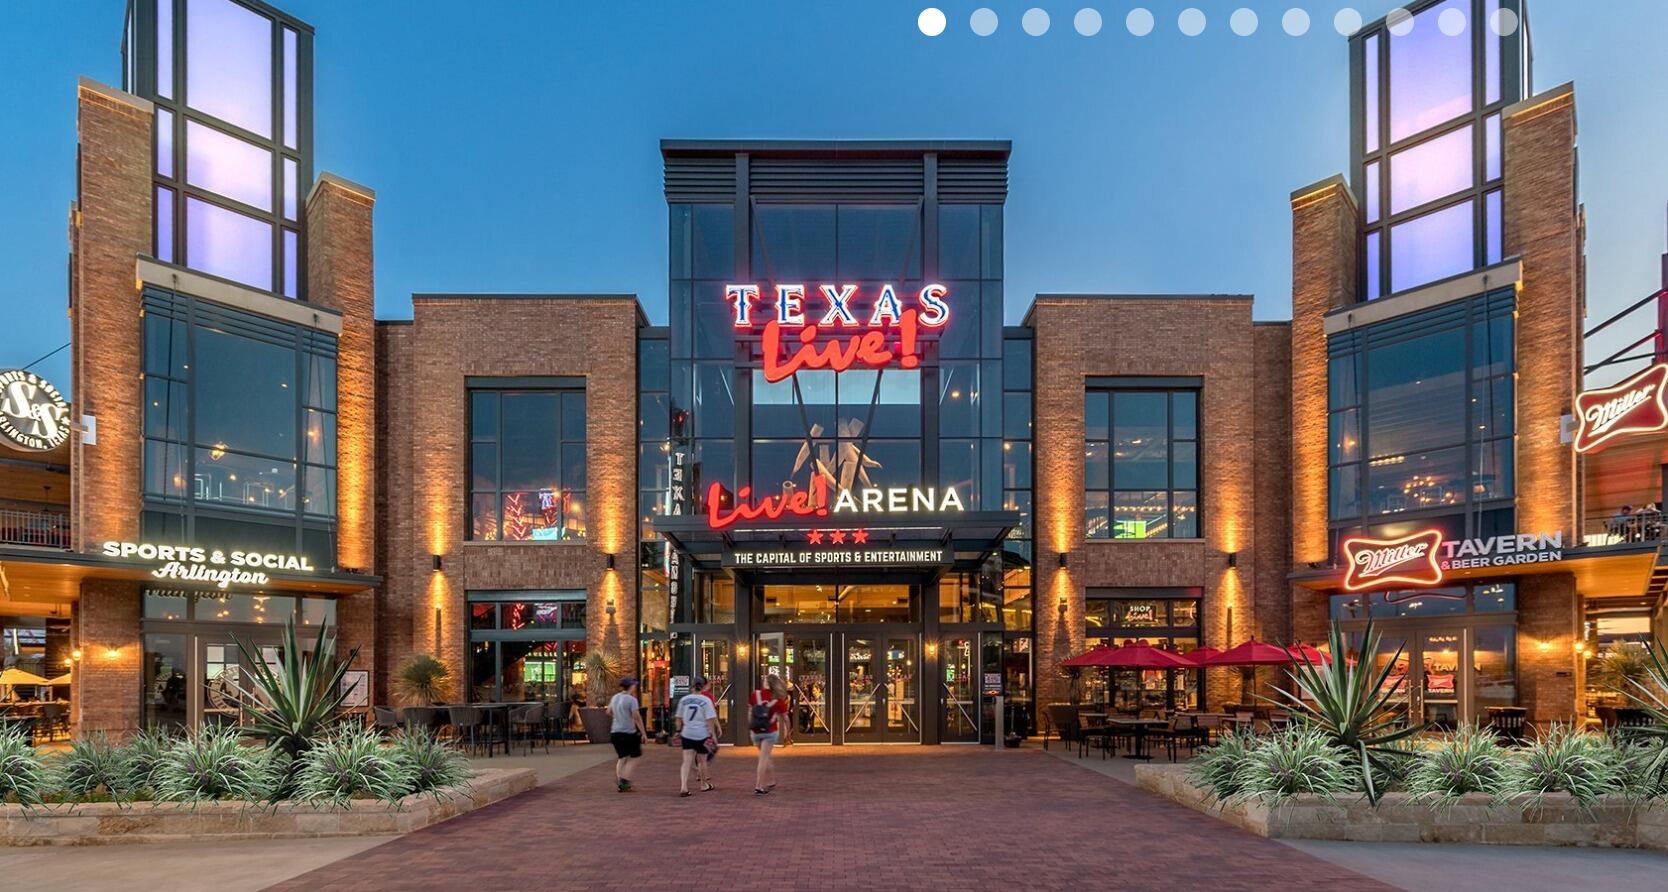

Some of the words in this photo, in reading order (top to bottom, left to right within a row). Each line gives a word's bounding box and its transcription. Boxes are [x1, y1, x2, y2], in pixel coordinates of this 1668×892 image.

[726, 284, 950, 327] TEXAS
[761, 309, 918, 383] Live!
[1585, 384, 1656, 430] Miller
[47, 425, 70, 447] TEXAS
[708, 474, 828, 529] Live!
[834, 487, 965, 512] ARENA
[103, 541, 206, 563] SPORTS
[209, 550, 226, 564] &
[230, 551, 314, 571] SOCIAL
[734, 553, 753, 564] THE
[756, 552, 796, 563] CAPITAL
[800, 552, 812, 563] OF
[814, 551, 852, 563] SPORTS
[854, 551, 861, 562] &
[864, 550, 943, 562] ENTERTAINMENT
[1444, 532, 1562, 557] TAVERN
[1355, 543, 1429, 575] Miller
[1441, 559, 1452, 571] &
[1453, 557, 1491, 570] BEER
[1493, 550, 1563, 567] GARDEN
[152, 561, 269, 588] Arlington
[688, 706, 698, 722] 7
